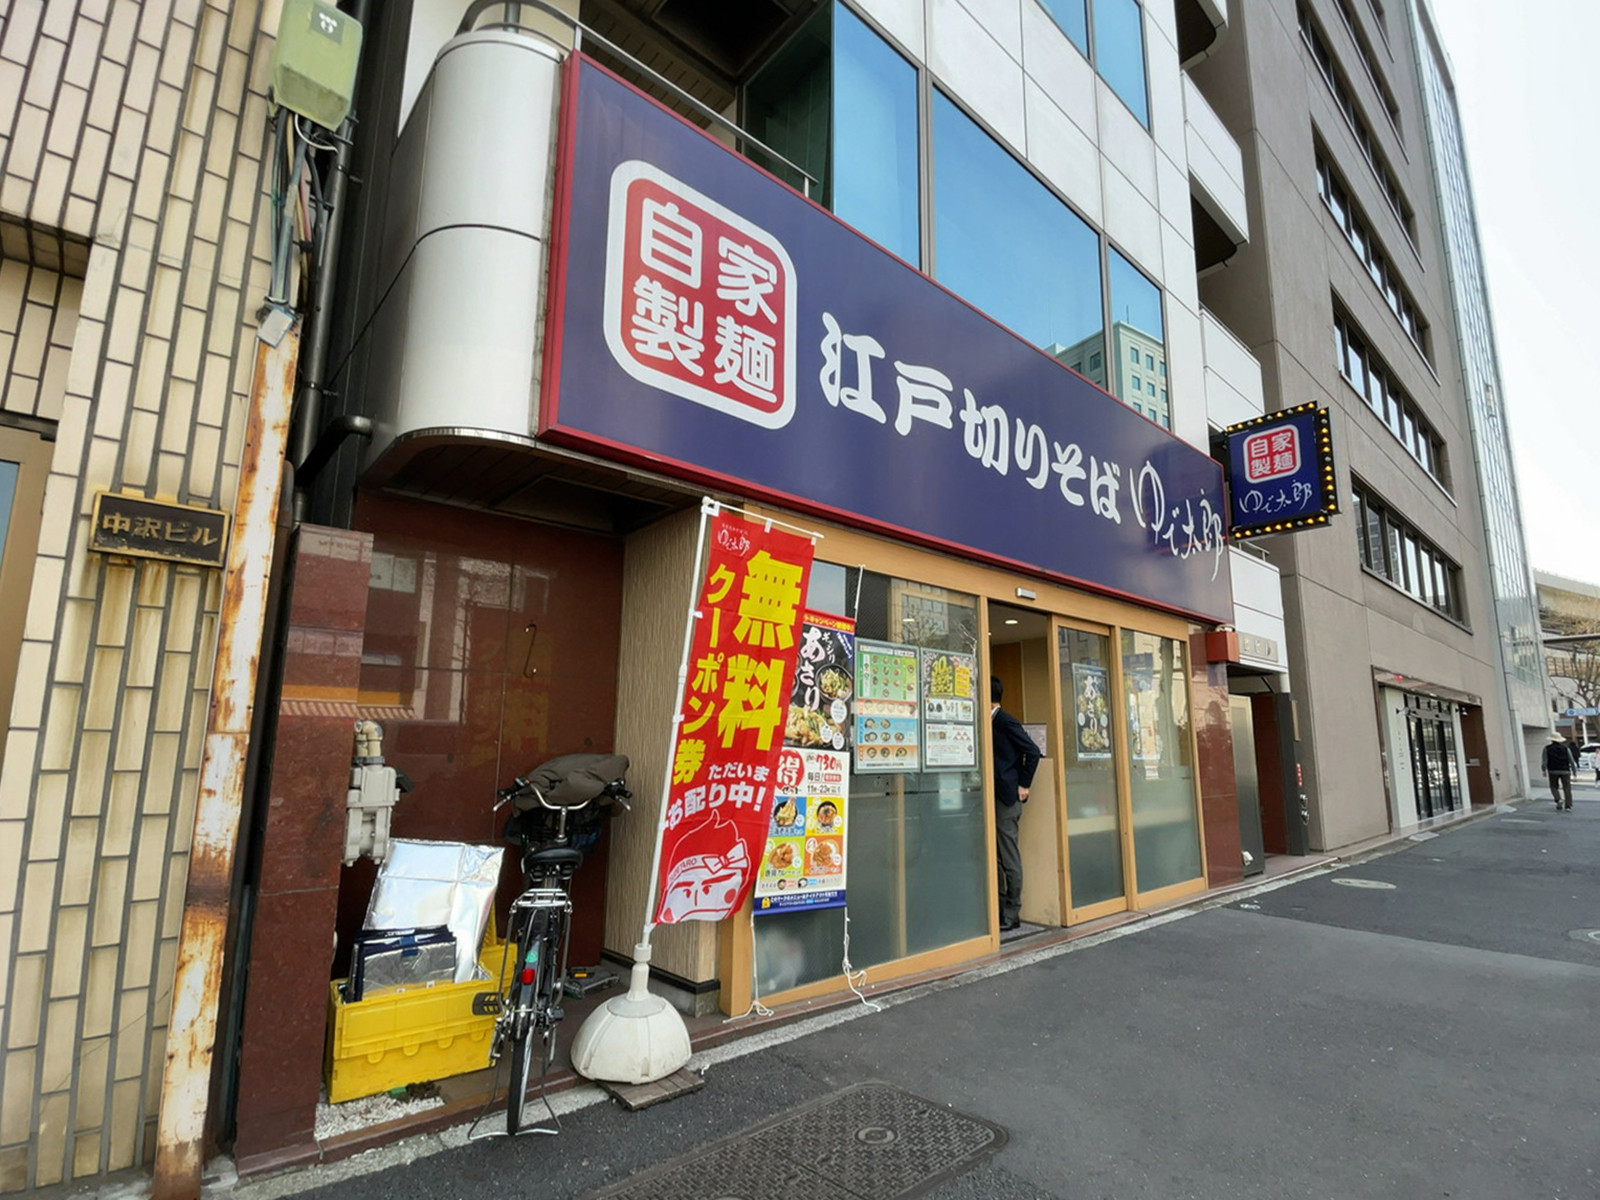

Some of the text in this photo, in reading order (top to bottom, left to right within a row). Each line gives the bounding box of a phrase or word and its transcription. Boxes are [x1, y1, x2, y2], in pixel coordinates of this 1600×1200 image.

[819, 311, 1224, 582] 江戸切りそば ゆで太郎
[1239, 479, 1313, 514] ゆで太郎
[102, 512, 218, 546] 中沢ビル
[673, 562, 736, 786] クーポン券
[717, 549, 803, 752] 無料
[800, 626, 826, 712] あさり
[707, 761, 770, 783] ただいま
[776, 754, 801, 788] 得
[667, 781, 767, 831] お配り中!
